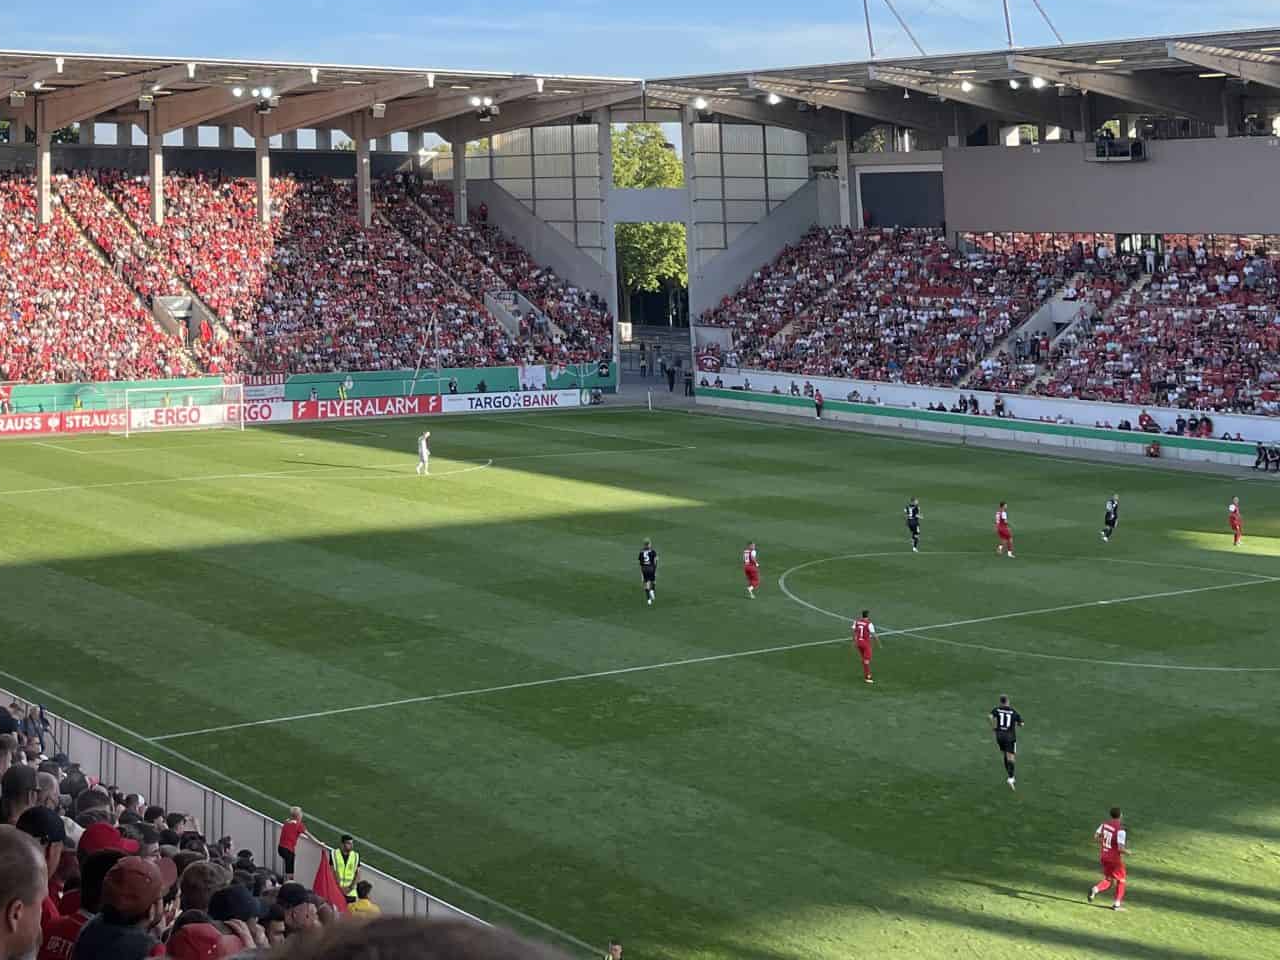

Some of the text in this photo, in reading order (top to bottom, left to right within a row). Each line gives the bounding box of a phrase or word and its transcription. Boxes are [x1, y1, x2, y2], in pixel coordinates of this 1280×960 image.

[154, 407, 200, 425] ERGO
[226, 404, 272, 422] ERGO
[318, 397, 419, 417] FLYERALARM
[66, 411, 126, 427] STRAUSS
[999, 713, 1011, 727] 11
